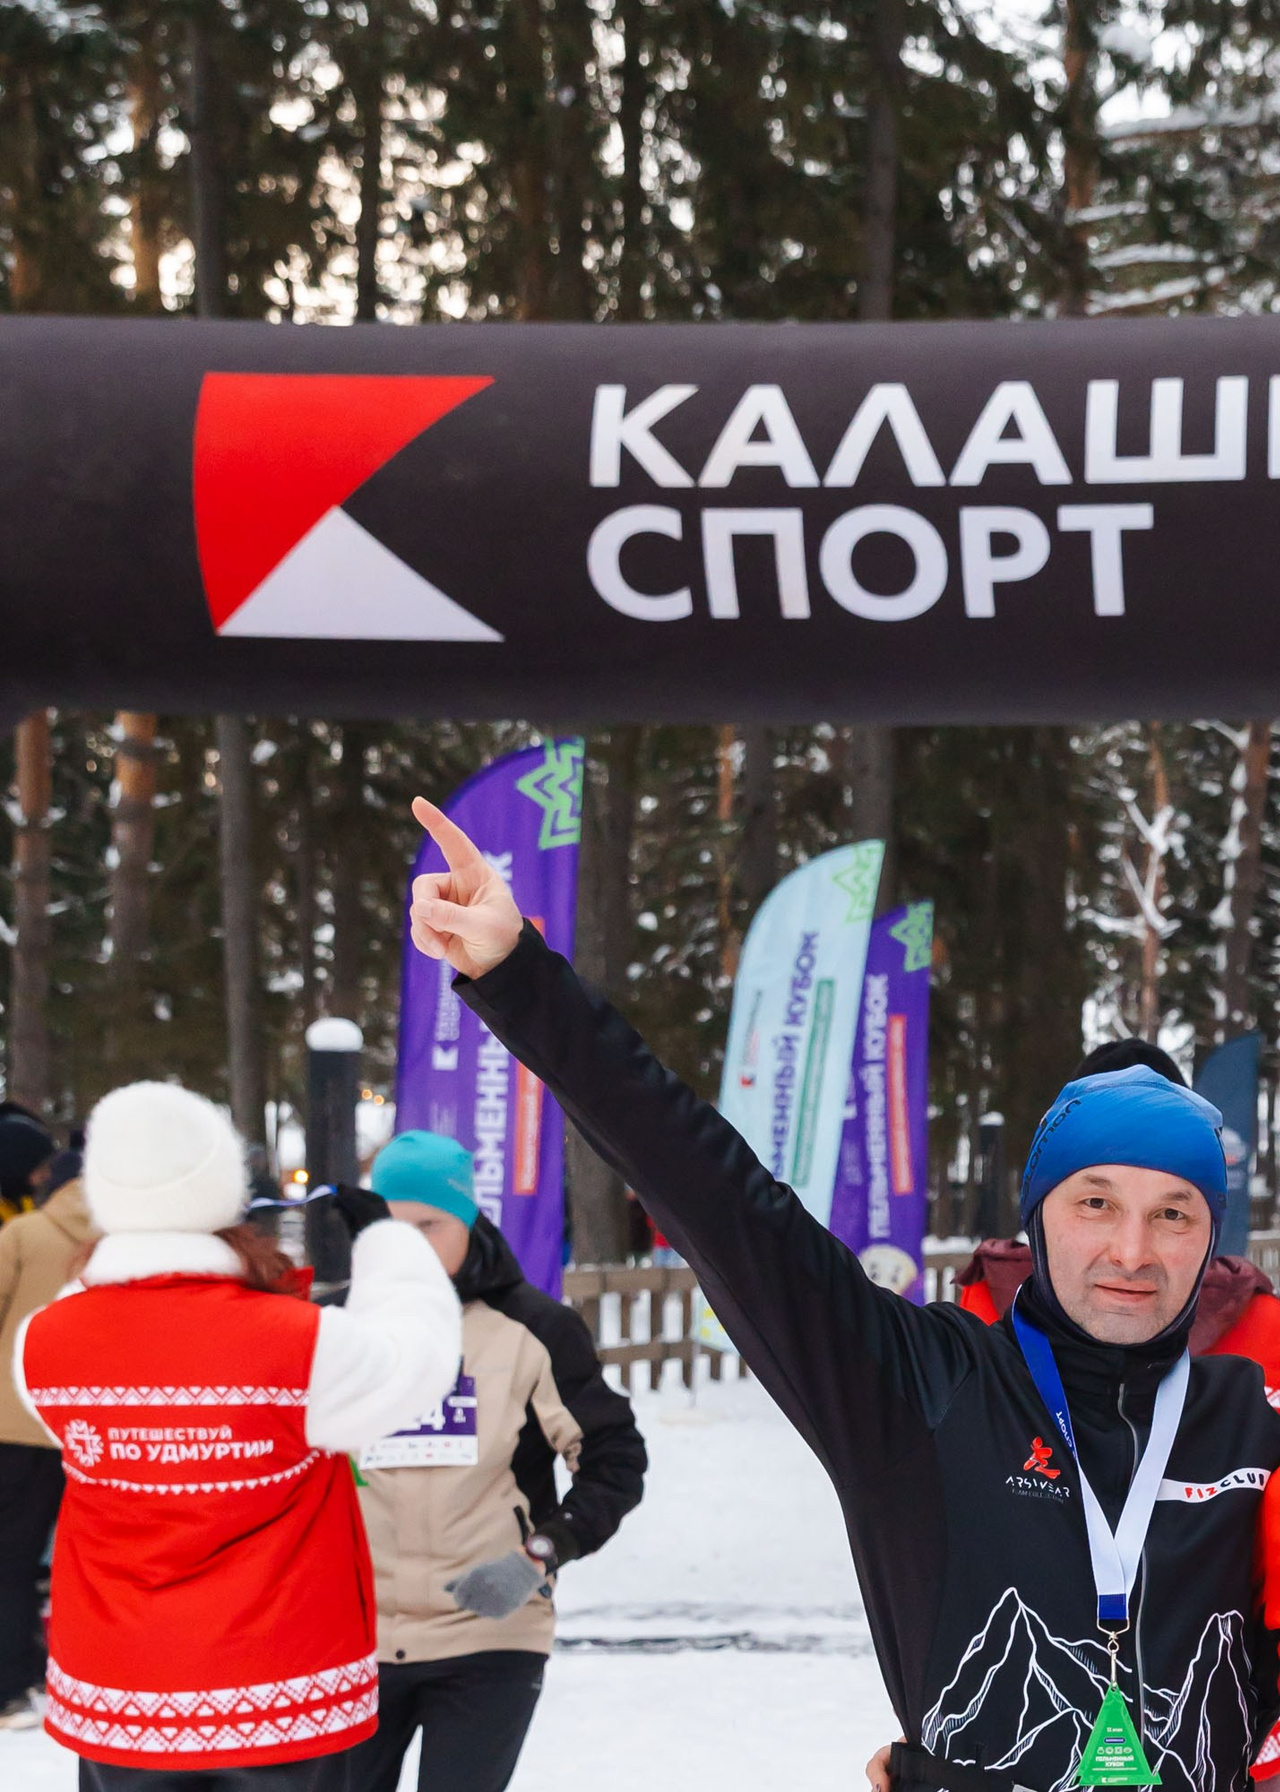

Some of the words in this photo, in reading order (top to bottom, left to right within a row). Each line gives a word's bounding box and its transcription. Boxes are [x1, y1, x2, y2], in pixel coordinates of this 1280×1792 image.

[586, 503, 1154, 622] СПОРТ
[784, 930, 820, 1027] КУБОК
[107, 1425, 232, 1441] ПУТЕШЕСТВУЙ
[110, 1442, 141, 1460] ПО
[146, 1439, 274, 1464] УДМУРТИИ
